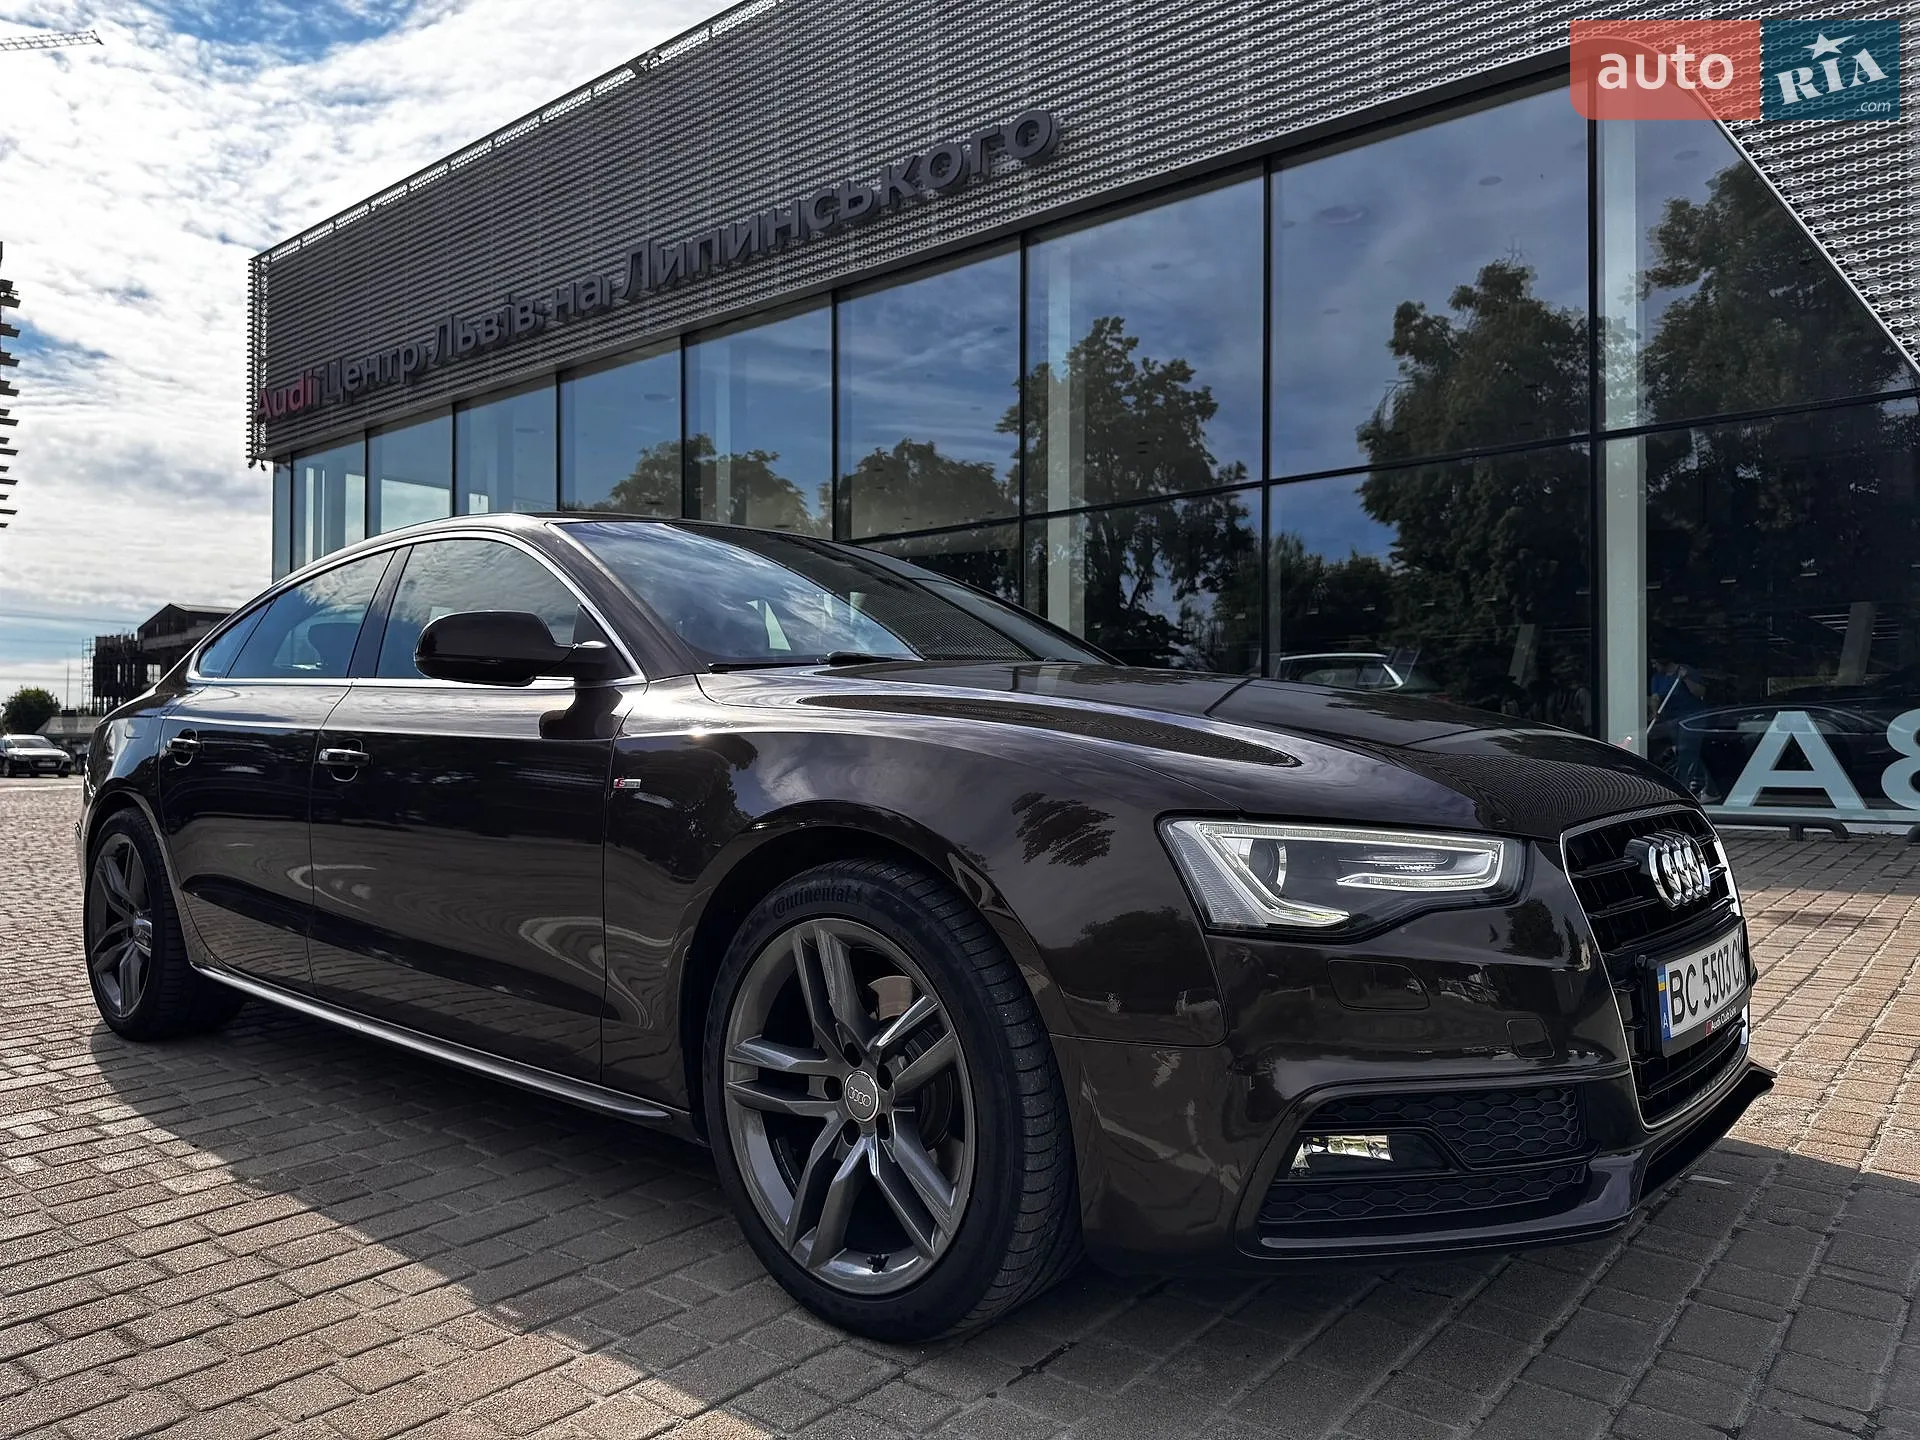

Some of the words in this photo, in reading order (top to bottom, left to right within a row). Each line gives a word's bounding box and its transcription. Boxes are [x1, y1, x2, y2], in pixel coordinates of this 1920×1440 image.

[255, 367, 316, 421] Audi
[322, 343, 423, 402] Центр
[431, 293, 540, 365] Львів
[551, 273, 613, 321] на
[618, 109, 1057, 300] Липинського
[773, 884, 852, 920] Continental
[1668, 963, 1699, 1026] BC
[1701, 944, 1731, 1009] 5503
